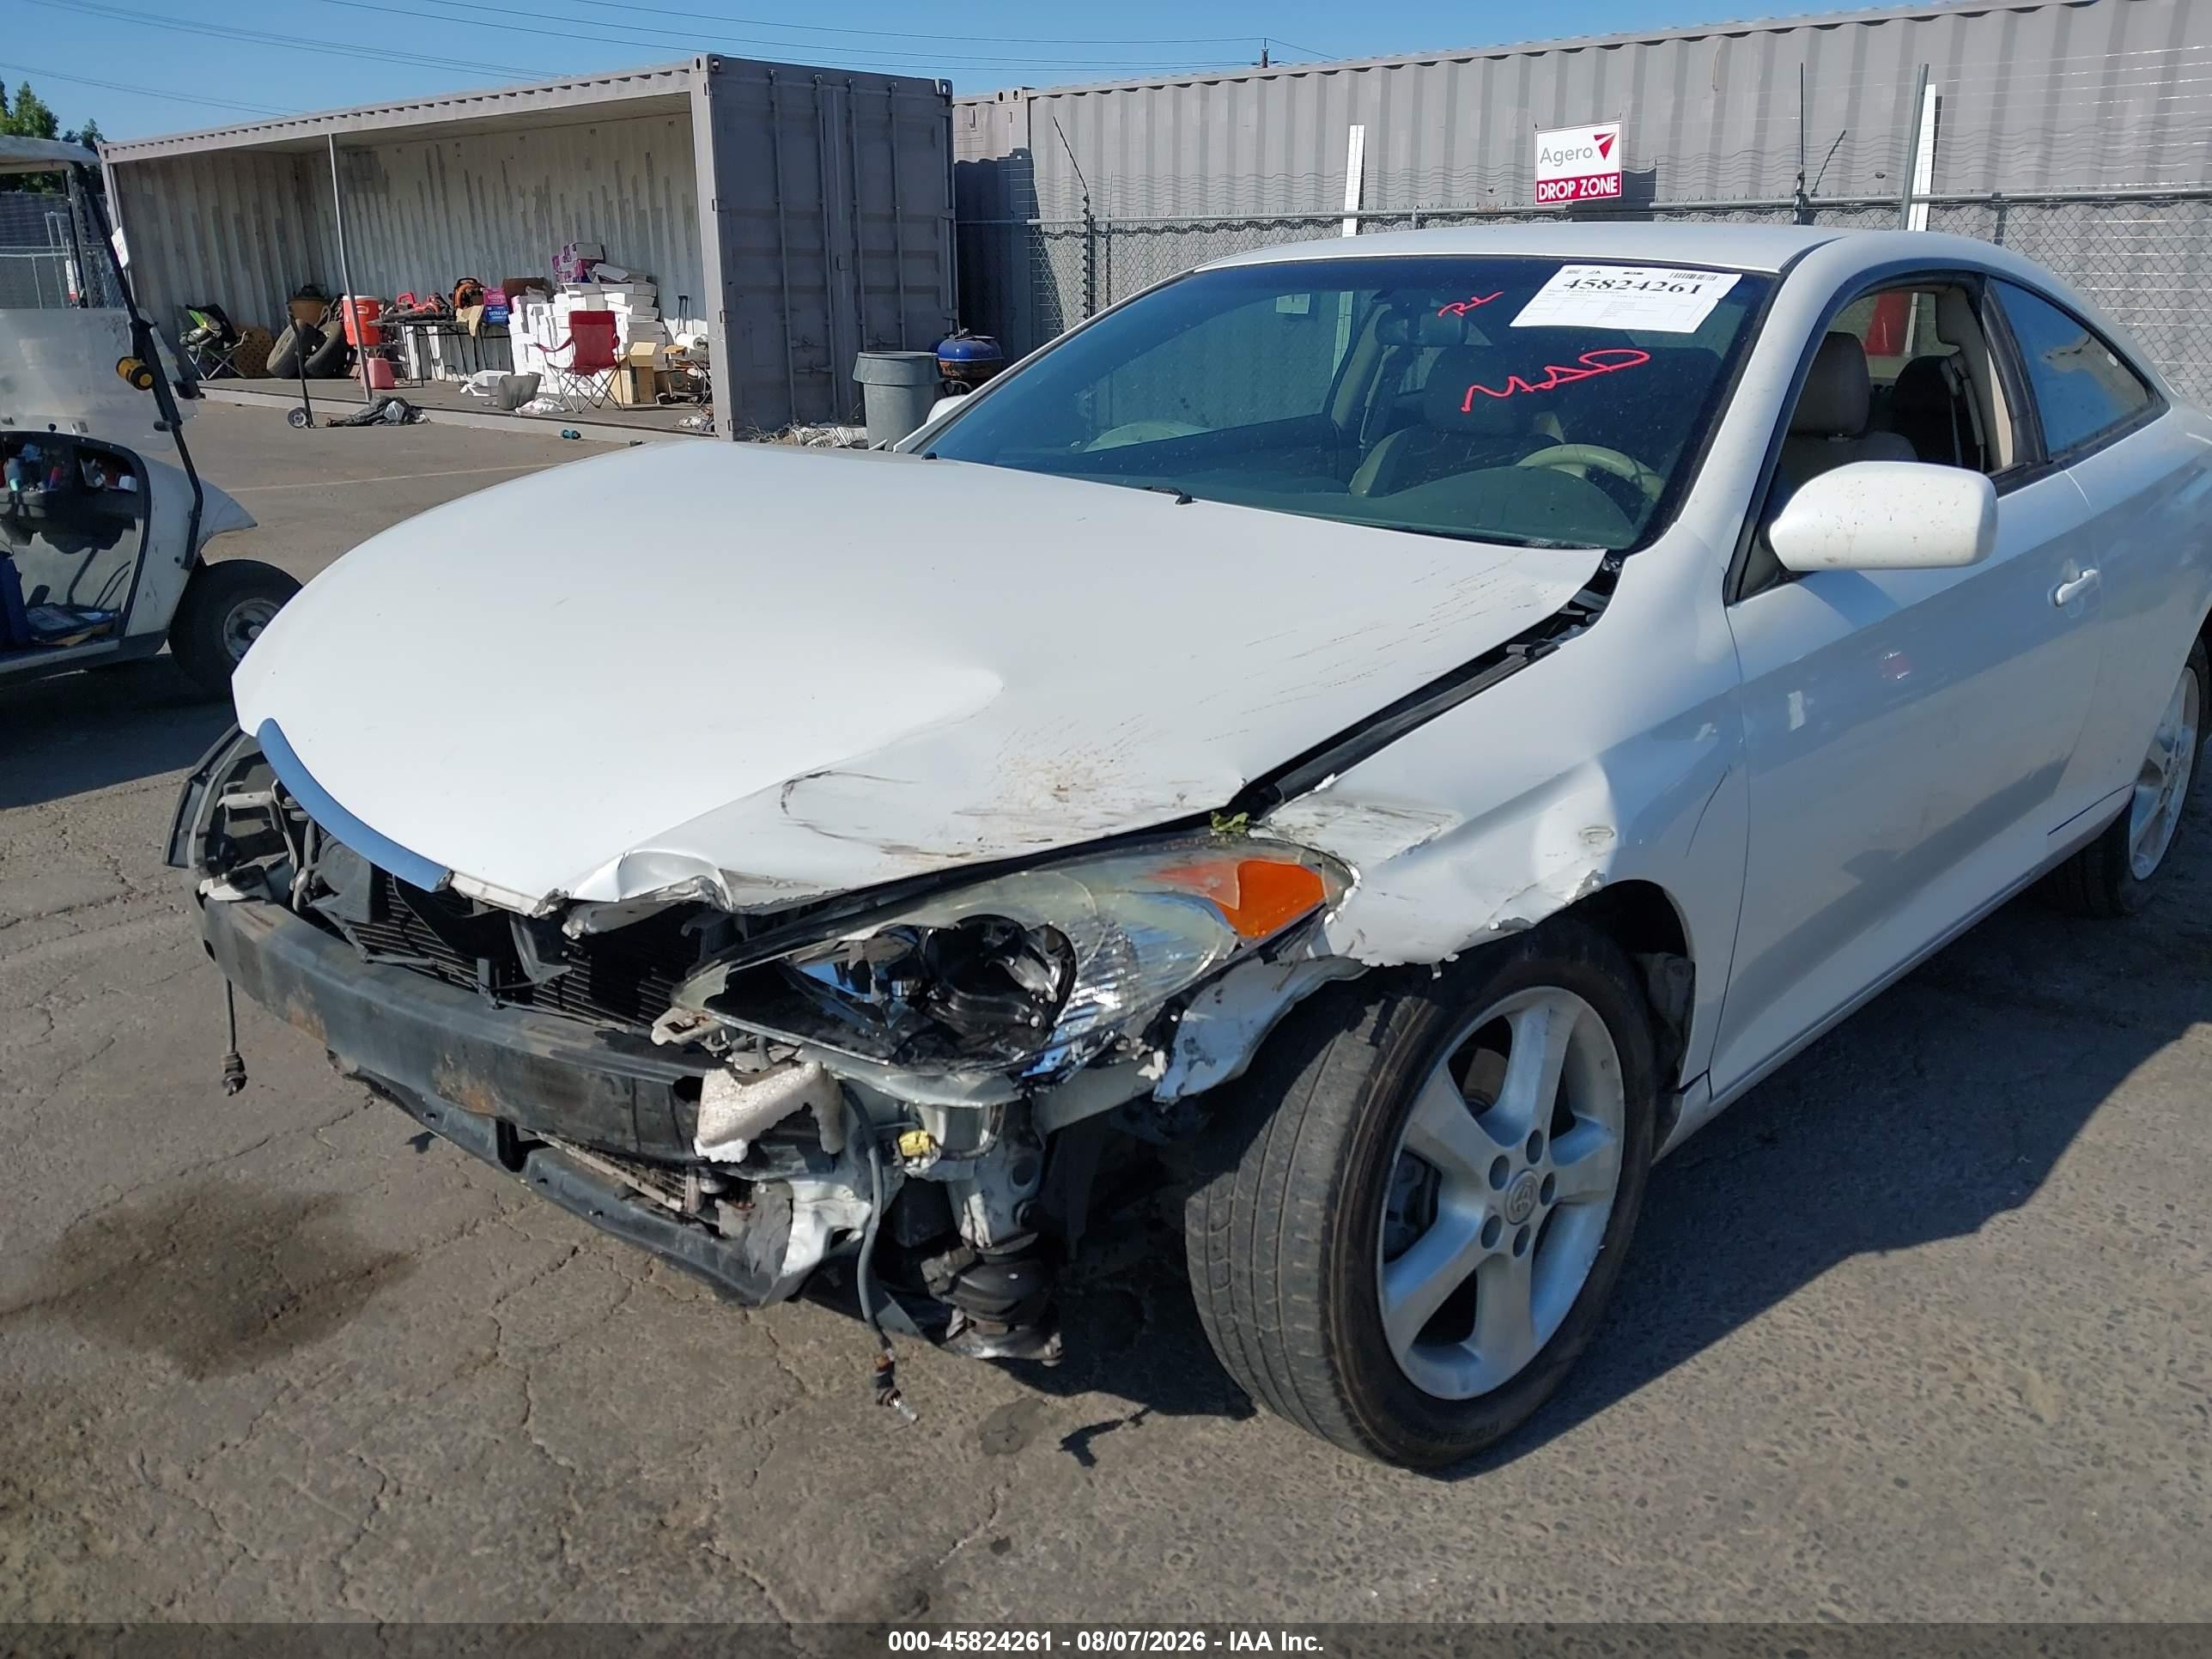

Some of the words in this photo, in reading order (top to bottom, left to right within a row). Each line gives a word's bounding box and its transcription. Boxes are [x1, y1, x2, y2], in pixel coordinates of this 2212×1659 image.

[1540, 147, 1593, 167] Agero
[1538, 180, 1577, 200] DROP
[1579, 176, 1618, 197] ZONE
[1563, 278, 1703, 295] 45824261
